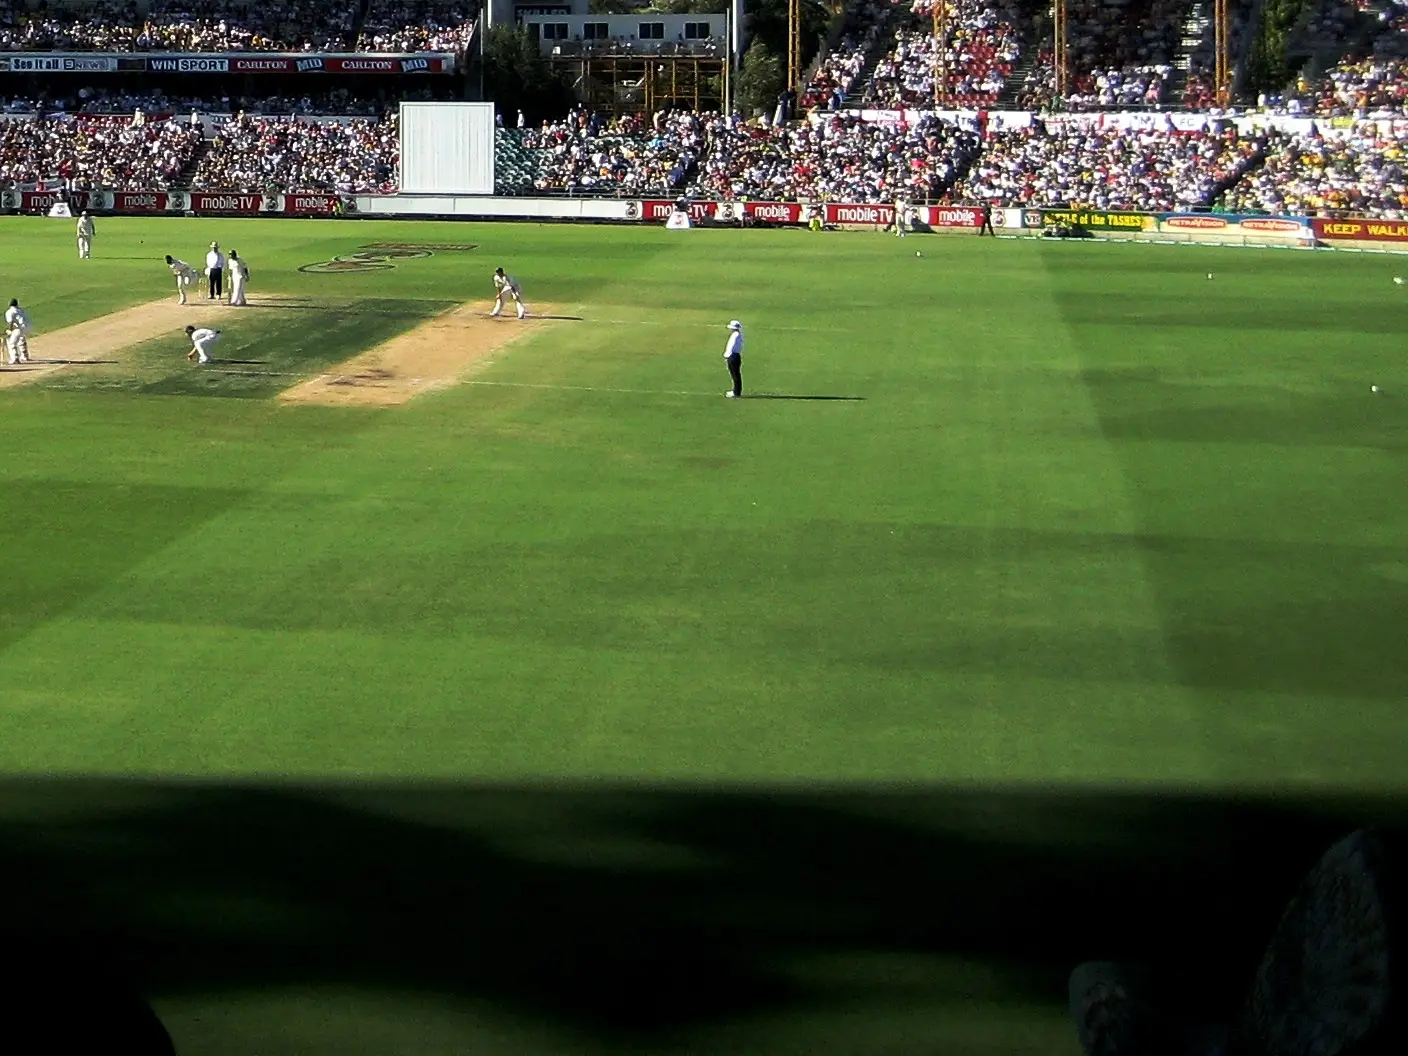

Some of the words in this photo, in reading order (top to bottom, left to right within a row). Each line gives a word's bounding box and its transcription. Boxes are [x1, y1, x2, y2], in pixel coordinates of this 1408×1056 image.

[13, 58, 32, 70] See
[34, 58, 43, 70] it
[44, 58, 60, 70] all
[151, 59, 177, 71] WIN
[180, 59, 226, 71] SPORT
[236, 59, 288, 69] CARLTON
[296, 58, 323, 71] MID
[341, 59, 393, 70] CARLTON
[401, 58, 428, 71] MID
[124, 194, 157, 206] mobile
[200, 196, 238, 210] mobile
[239, 196, 254, 210] TV
[294, 196, 329, 208] mobile
[754, 203, 791, 217] mobile
[837, 207, 878, 222] mobile
[879, 208, 894, 223] TV
[939, 209, 976, 223] mobile
[1079, 213, 1089, 225] of
[1091, 213, 1105, 225] the
[1323, 224, 1362, 236] KEEP
